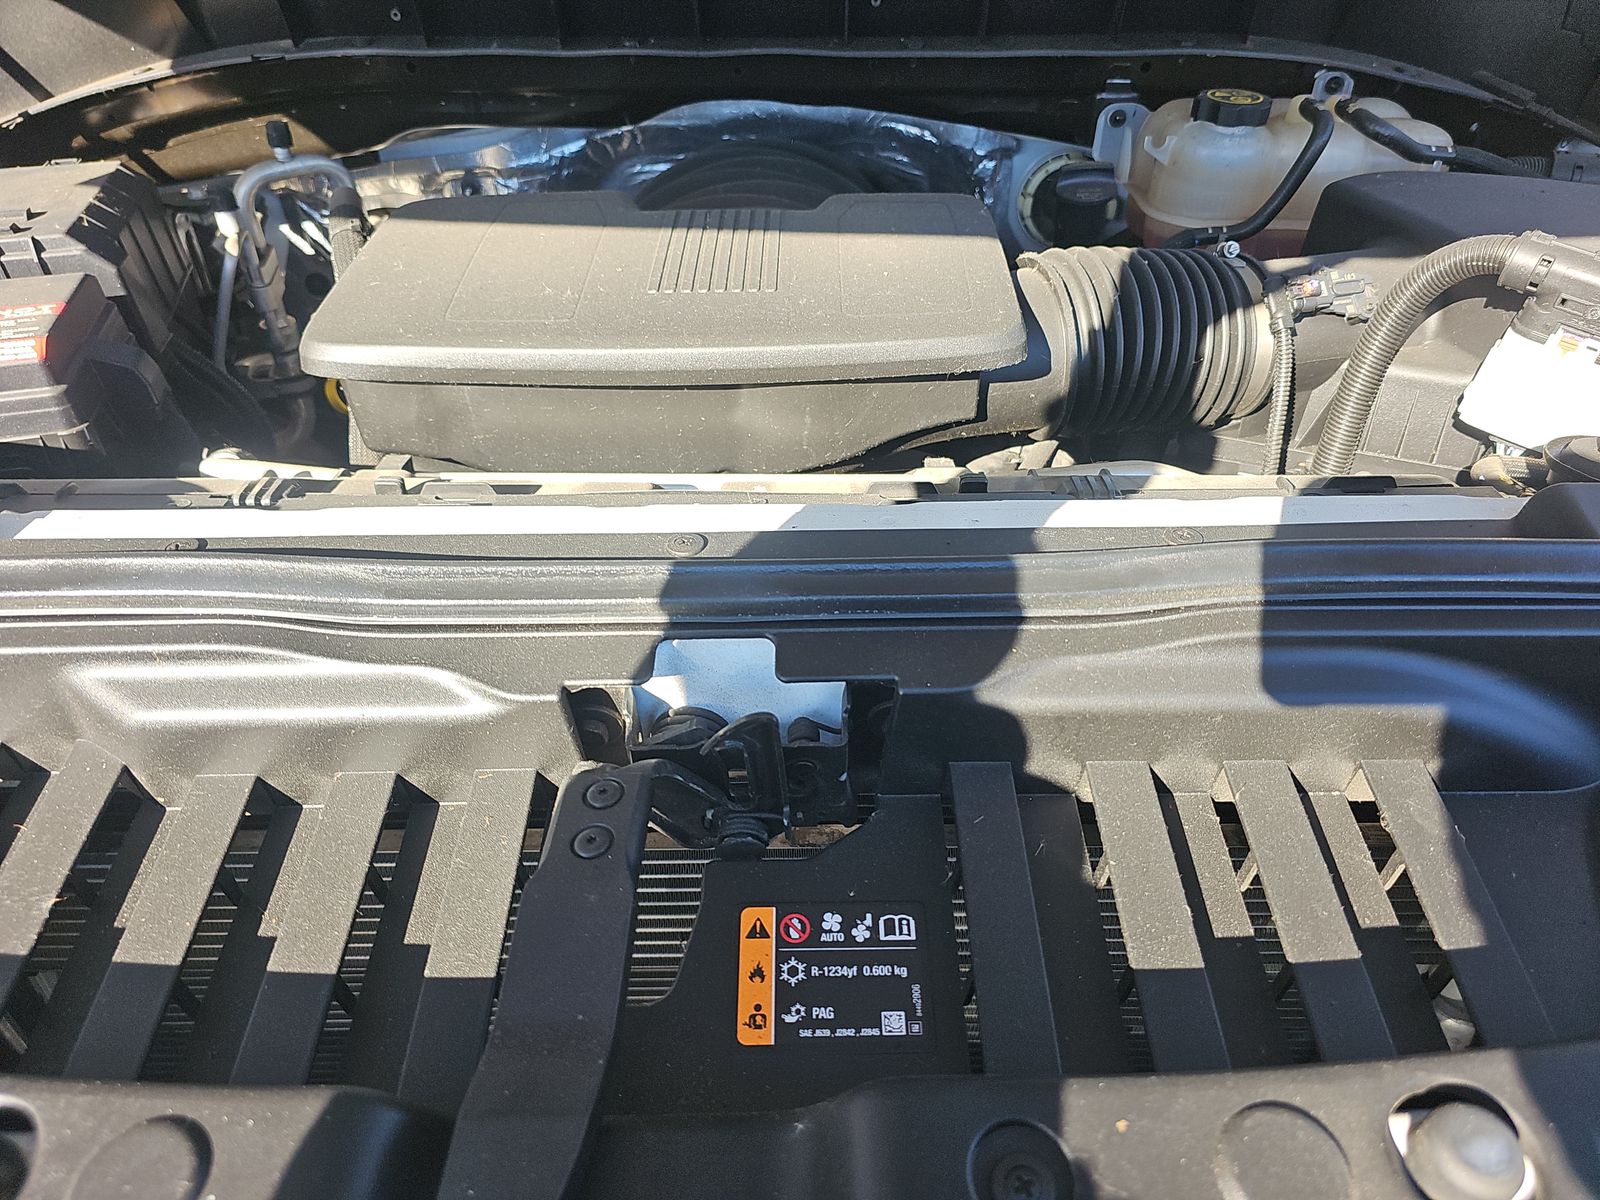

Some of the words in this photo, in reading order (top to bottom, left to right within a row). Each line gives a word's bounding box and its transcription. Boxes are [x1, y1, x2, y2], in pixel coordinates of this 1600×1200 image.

[820, 932, 845, 942] AUTO
[810, 966, 858, 979] R-1234yf
[862, 965, 892, 976] 0.600
[893, 965, 908, 978] kg
[812, 1006, 835, 1019] PAG
[798, 1029, 813, 1037] SAE
